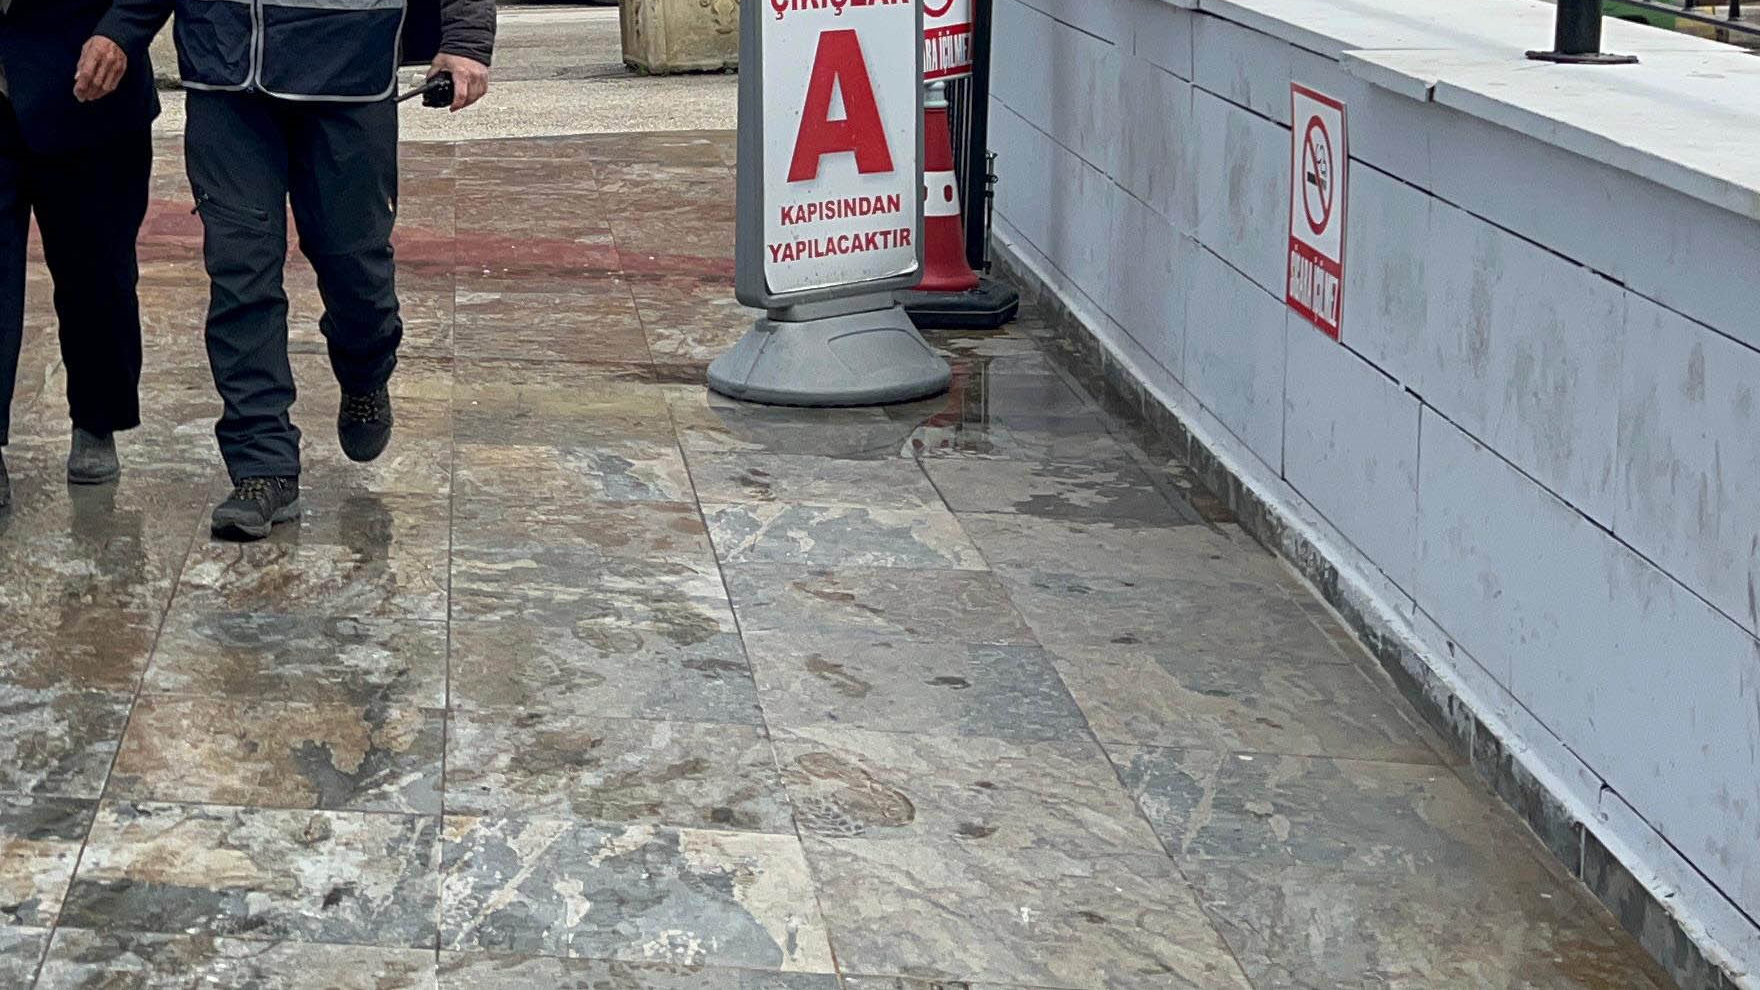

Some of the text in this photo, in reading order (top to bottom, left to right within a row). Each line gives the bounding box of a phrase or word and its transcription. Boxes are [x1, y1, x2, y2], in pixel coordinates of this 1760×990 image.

[787, 28, 895, 183] A
[780, 194, 901, 227] KAPISINDAN
[768, 227, 912, 263] YAPILACAKTIR
